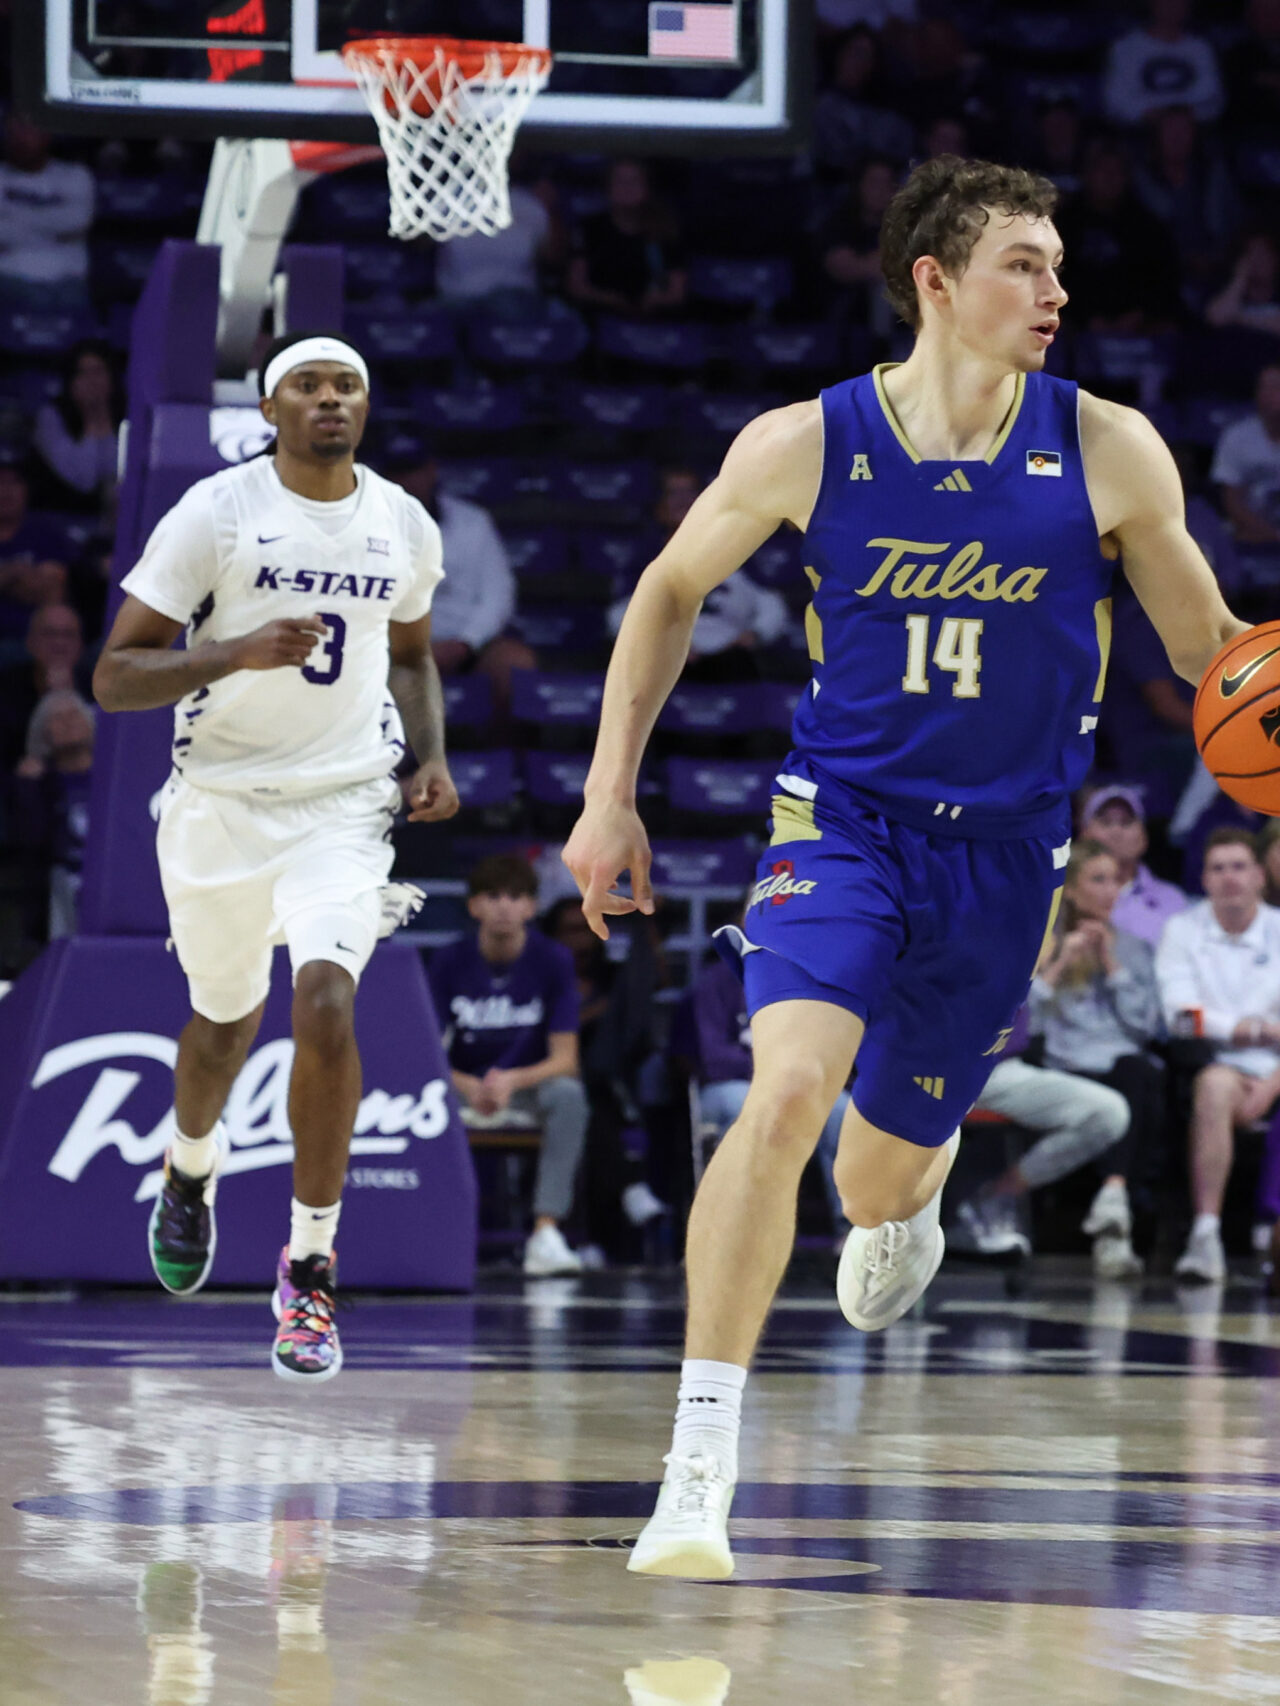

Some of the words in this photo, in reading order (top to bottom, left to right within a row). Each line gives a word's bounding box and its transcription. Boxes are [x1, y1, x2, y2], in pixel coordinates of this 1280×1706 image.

[253, 566, 397, 601] K-STATE
[855, 537, 1048, 603] Tulsa
[301, 612, 346, 686] 3
[902, 613, 984, 698] 14
